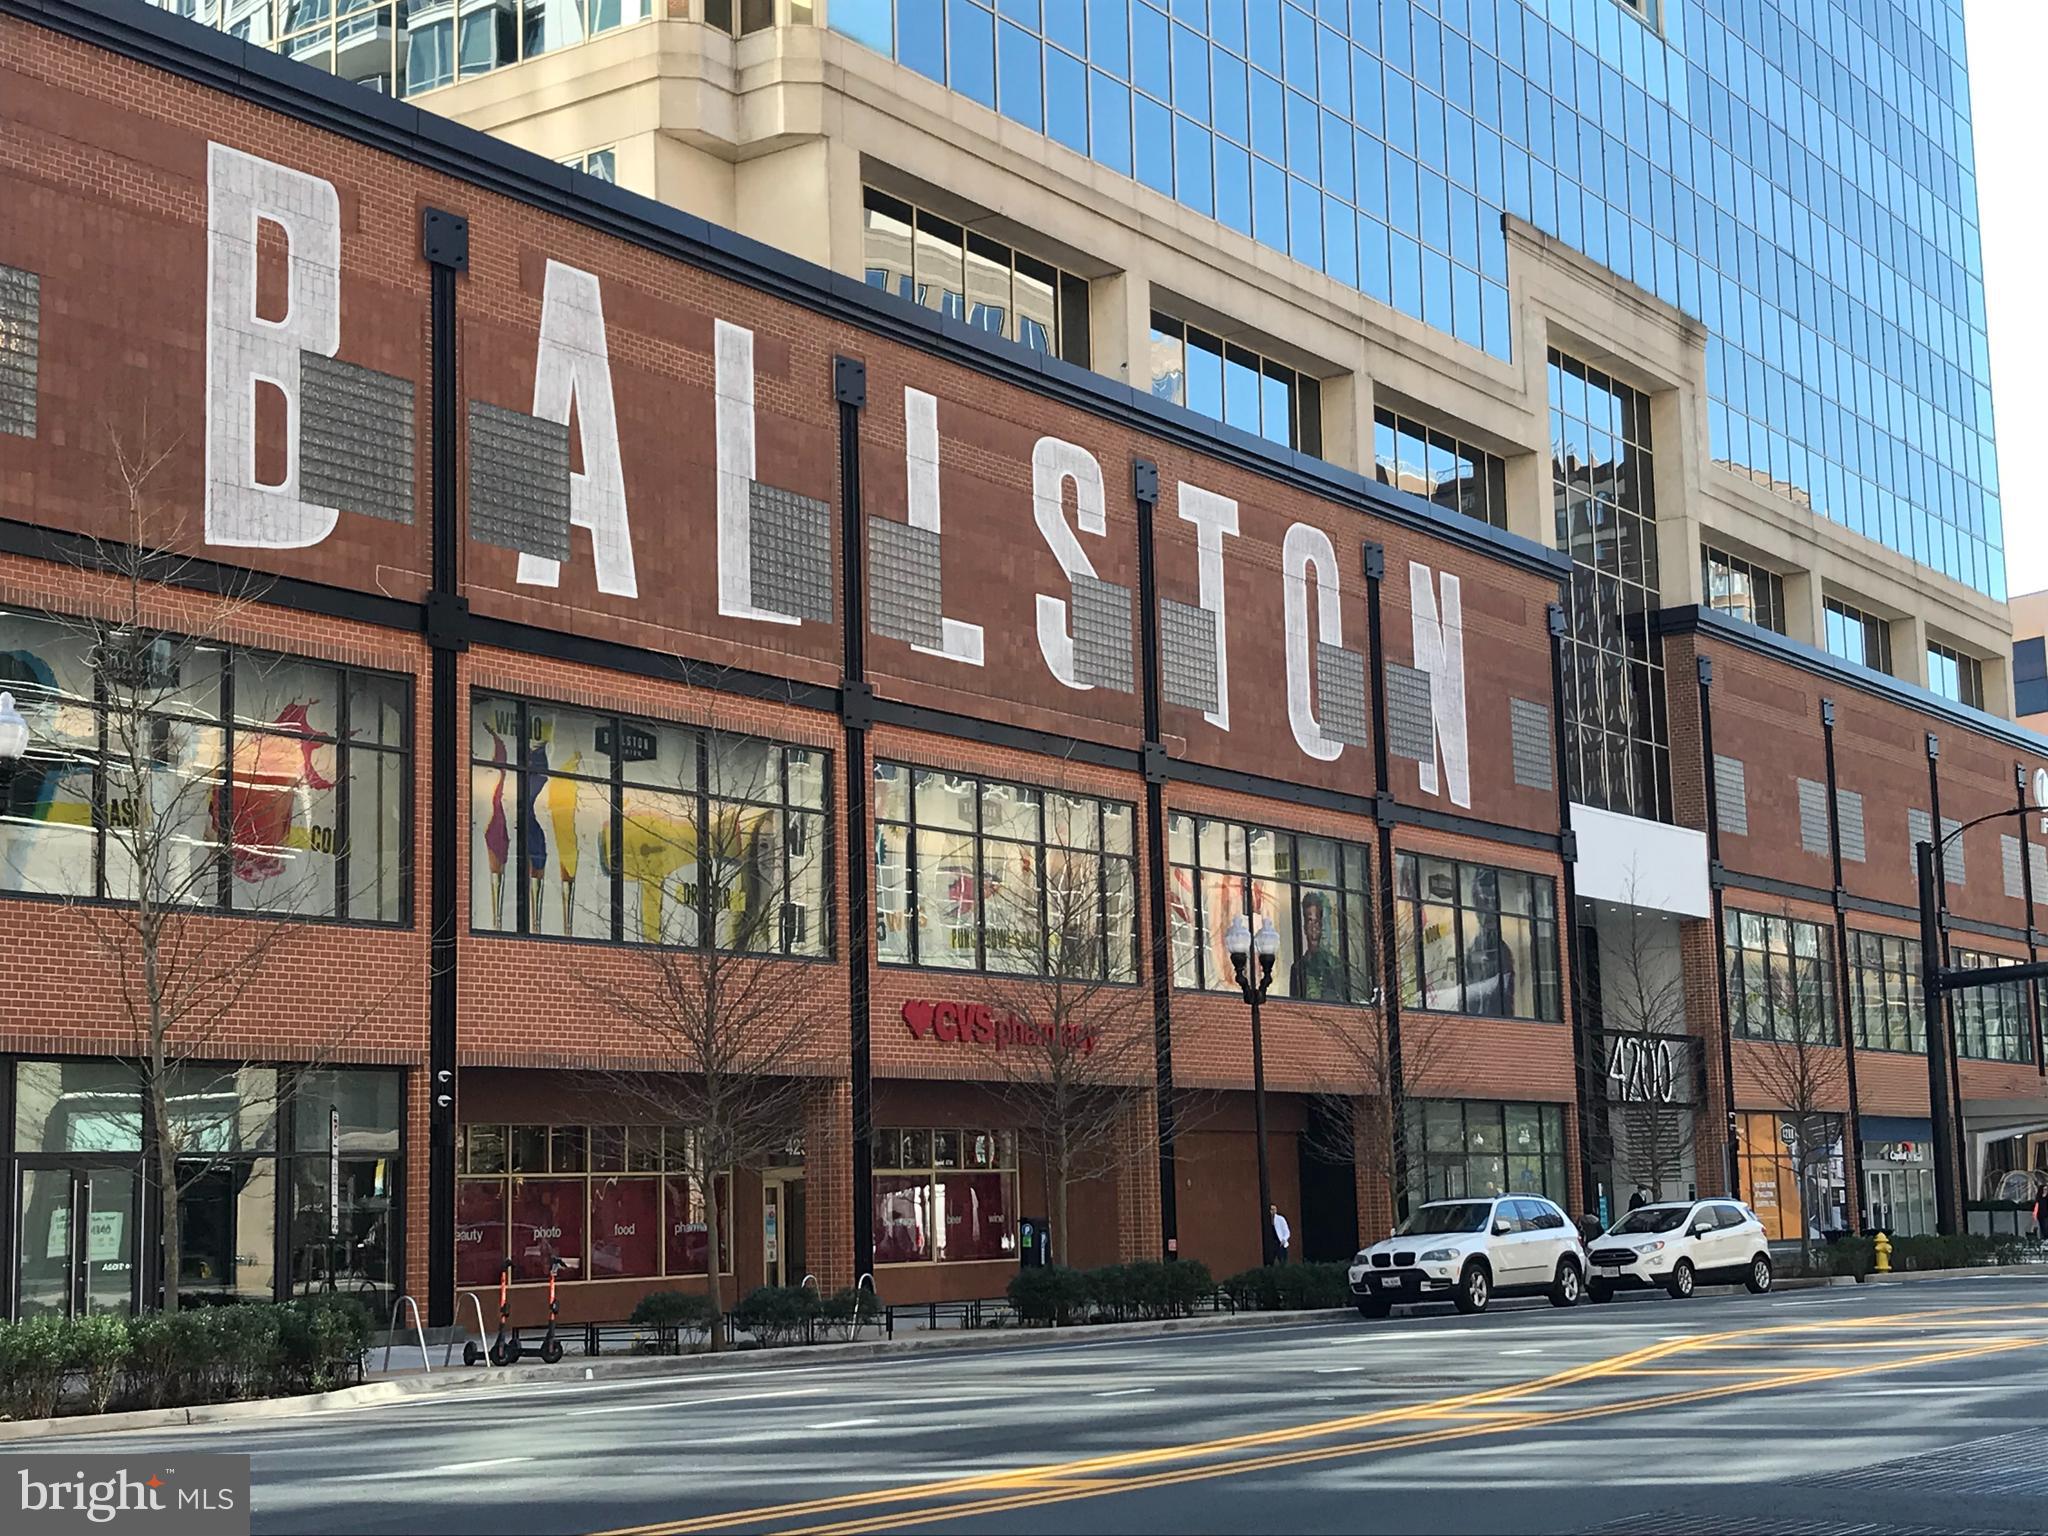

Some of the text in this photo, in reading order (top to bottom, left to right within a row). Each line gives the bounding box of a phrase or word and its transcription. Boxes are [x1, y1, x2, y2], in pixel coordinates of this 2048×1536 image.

[204, 140, 1471, 810] BALLSTON
[603, 731, 649, 751] BLSTON
[933, 1001, 994, 1043] CVS
[1609, 1036, 1673, 1102] 4200
[455, 1228, 483, 1243] eauty
[533, 1225, 562, 1241] photo
[614, 1223, 636, 1236] food
[674, 1222, 708, 1236] pharma
